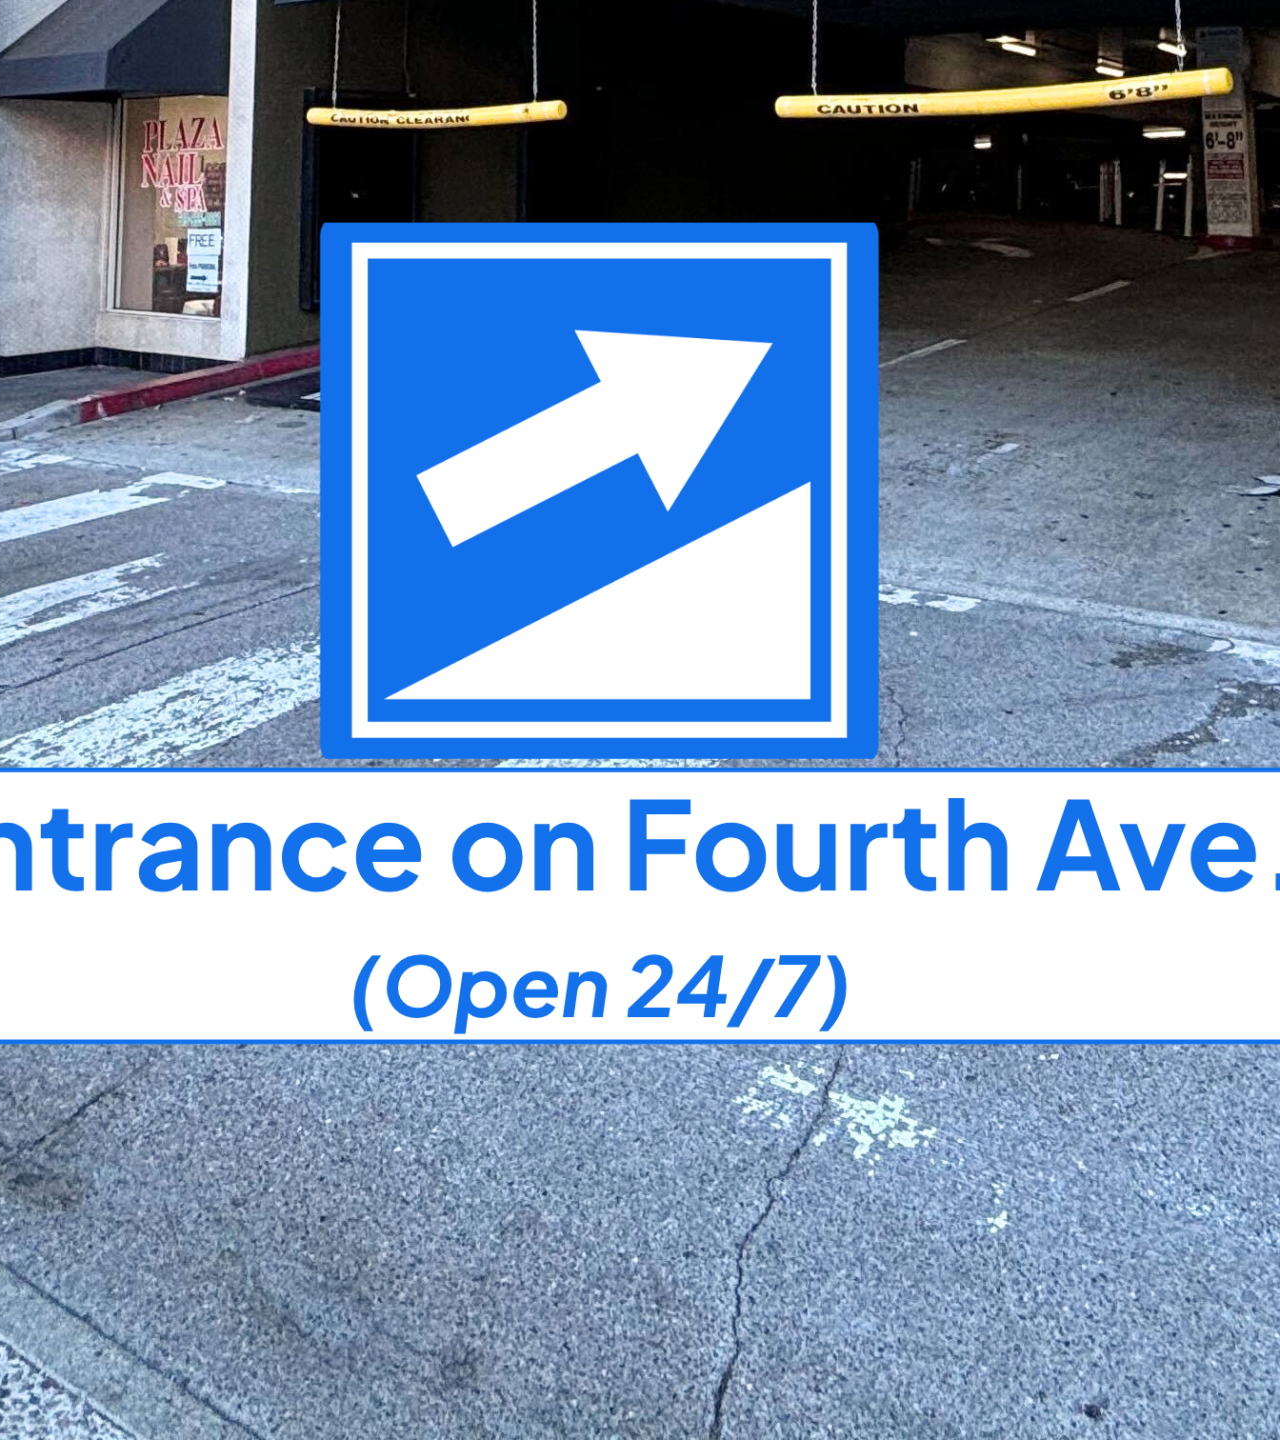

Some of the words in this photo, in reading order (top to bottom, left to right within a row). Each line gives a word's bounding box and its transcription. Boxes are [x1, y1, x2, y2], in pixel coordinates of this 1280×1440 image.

[816, 103, 920, 116] CAUTION
[143, 116, 225, 154] PLAZA
[141, 152, 206, 189] NAIL
[159, 186, 173, 208] &
[174, 185, 208, 212] SPA
[189, 233, 215, 248] FREE
